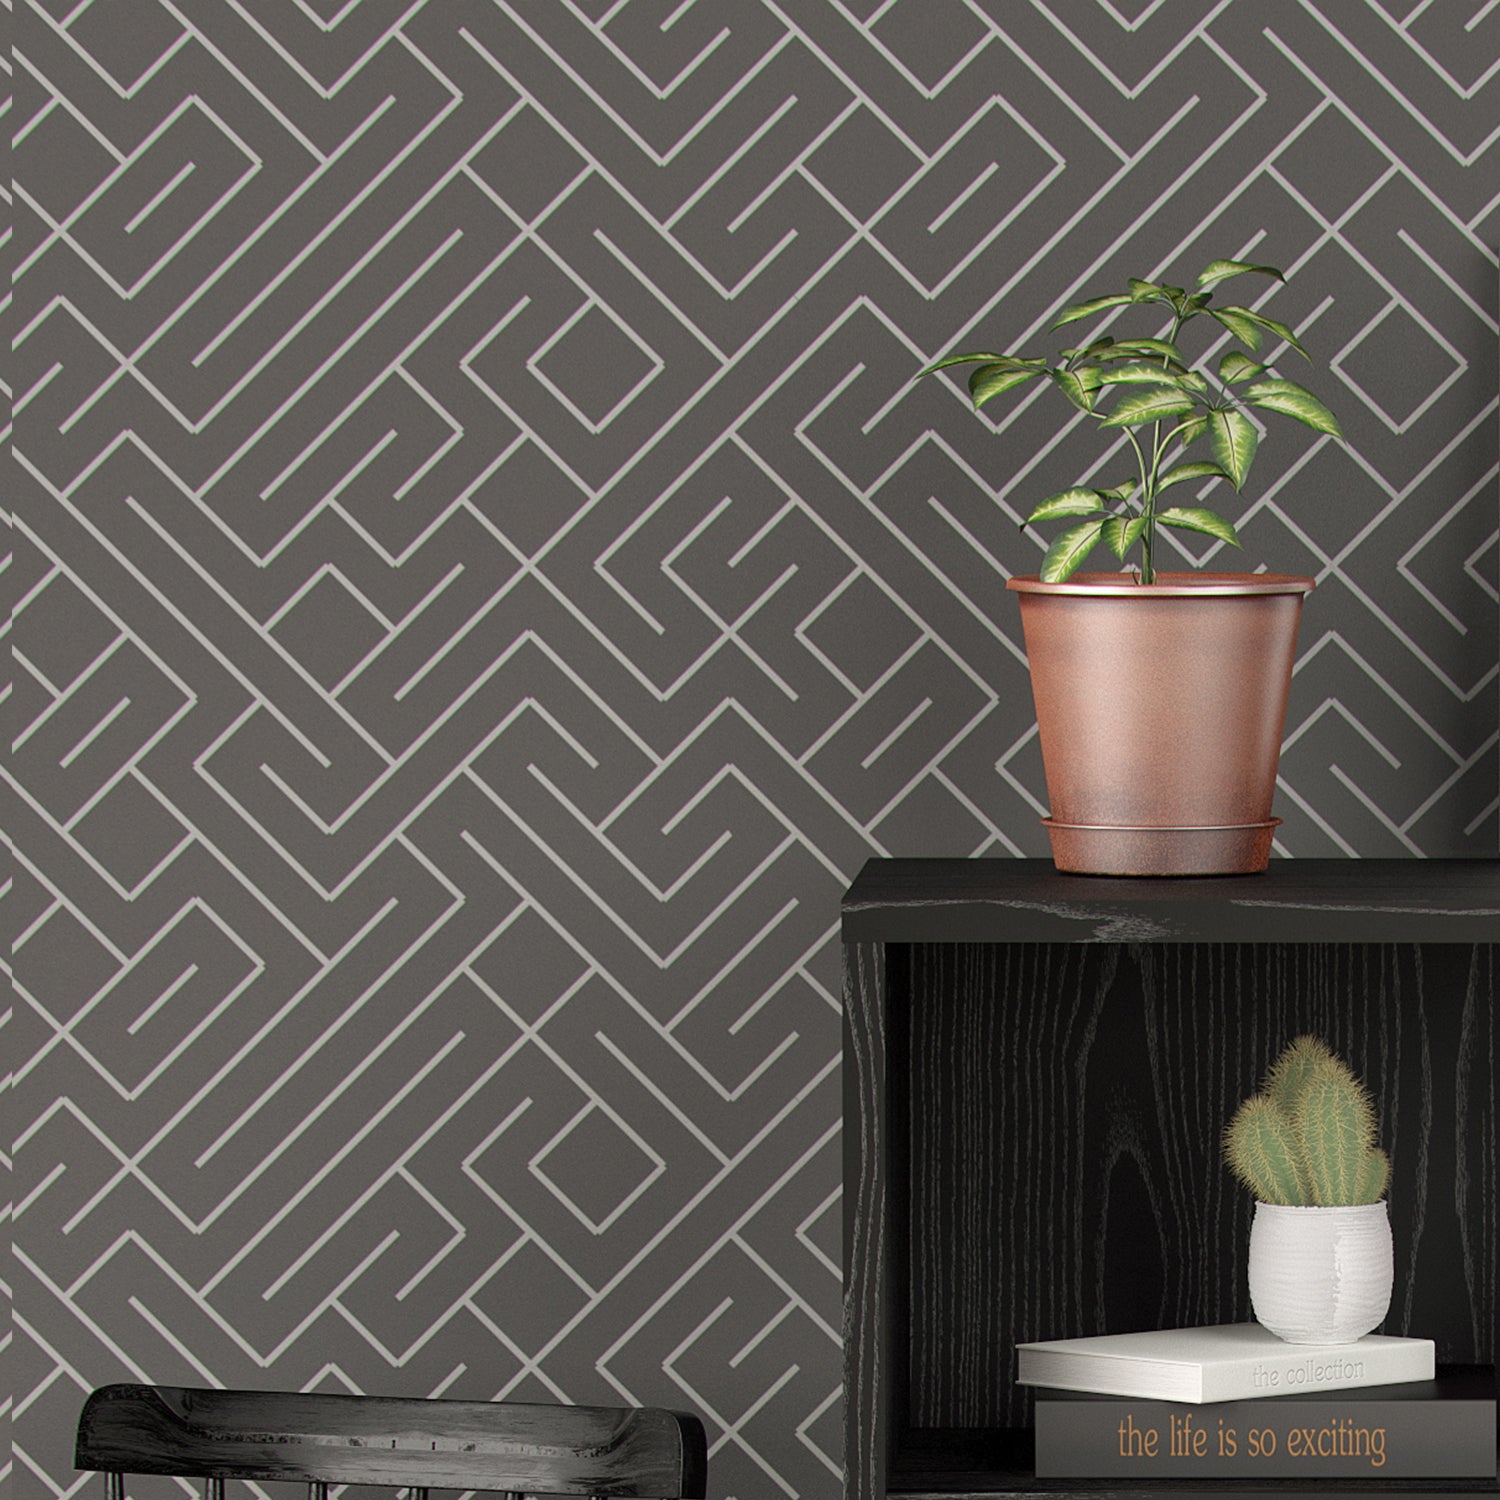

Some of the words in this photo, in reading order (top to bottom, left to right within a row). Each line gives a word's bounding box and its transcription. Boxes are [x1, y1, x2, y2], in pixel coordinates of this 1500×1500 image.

[1253, 1365, 1280, 1388] the
[1286, 1360, 1365, 1386] collection
[1118, 1414, 1158, 1457] the
[1169, 1413, 1207, 1457] life
[1218, 1419, 1238, 1457] is
[1248, 1428, 1277, 1457] so
[1287, 1418, 1386, 1467] exciting
